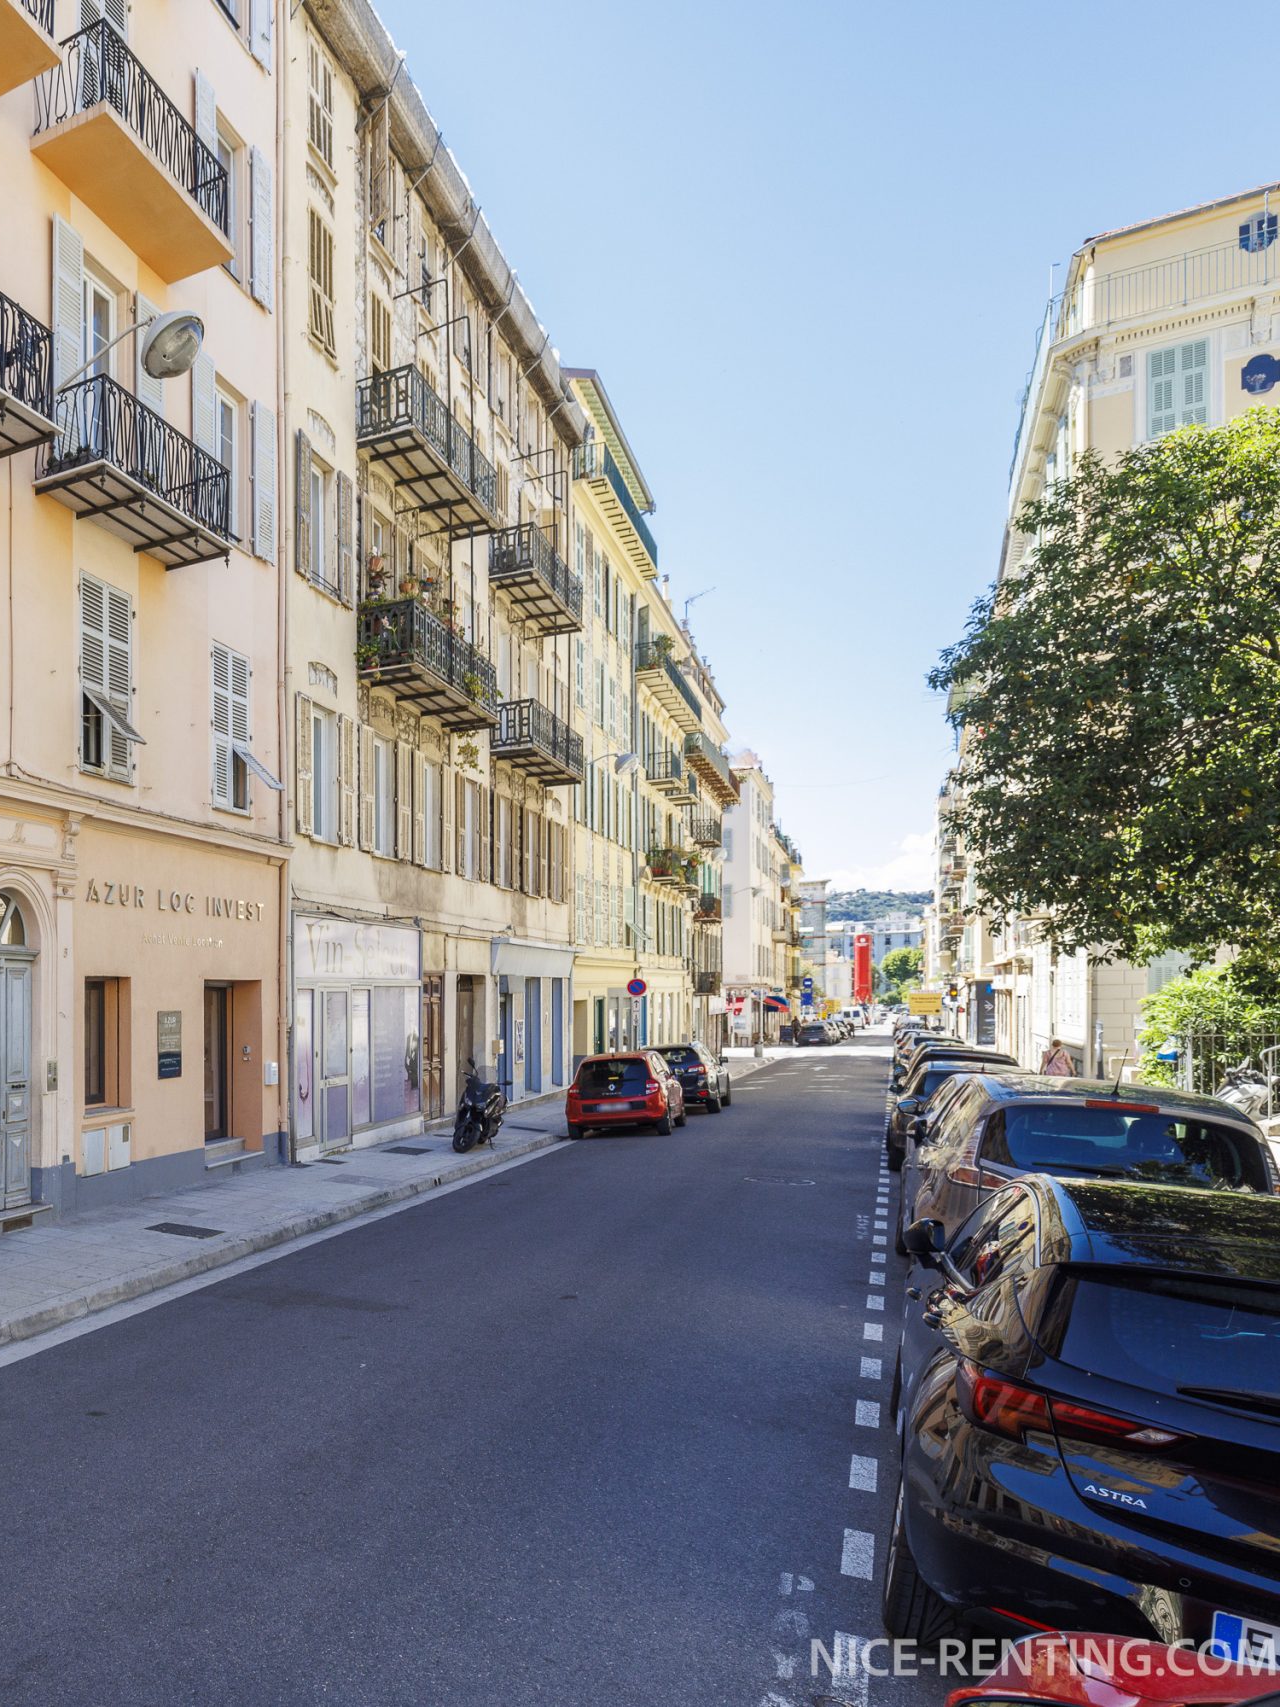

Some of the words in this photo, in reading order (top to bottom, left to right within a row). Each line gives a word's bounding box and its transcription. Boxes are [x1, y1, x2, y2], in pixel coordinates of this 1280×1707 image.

[86, 878, 145, 908] AZUR
[157, 889, 195, 914] LOC
[205, 896, 265, 922] INVEST
[1084, 1484, 1147, 1510] ASTRA
